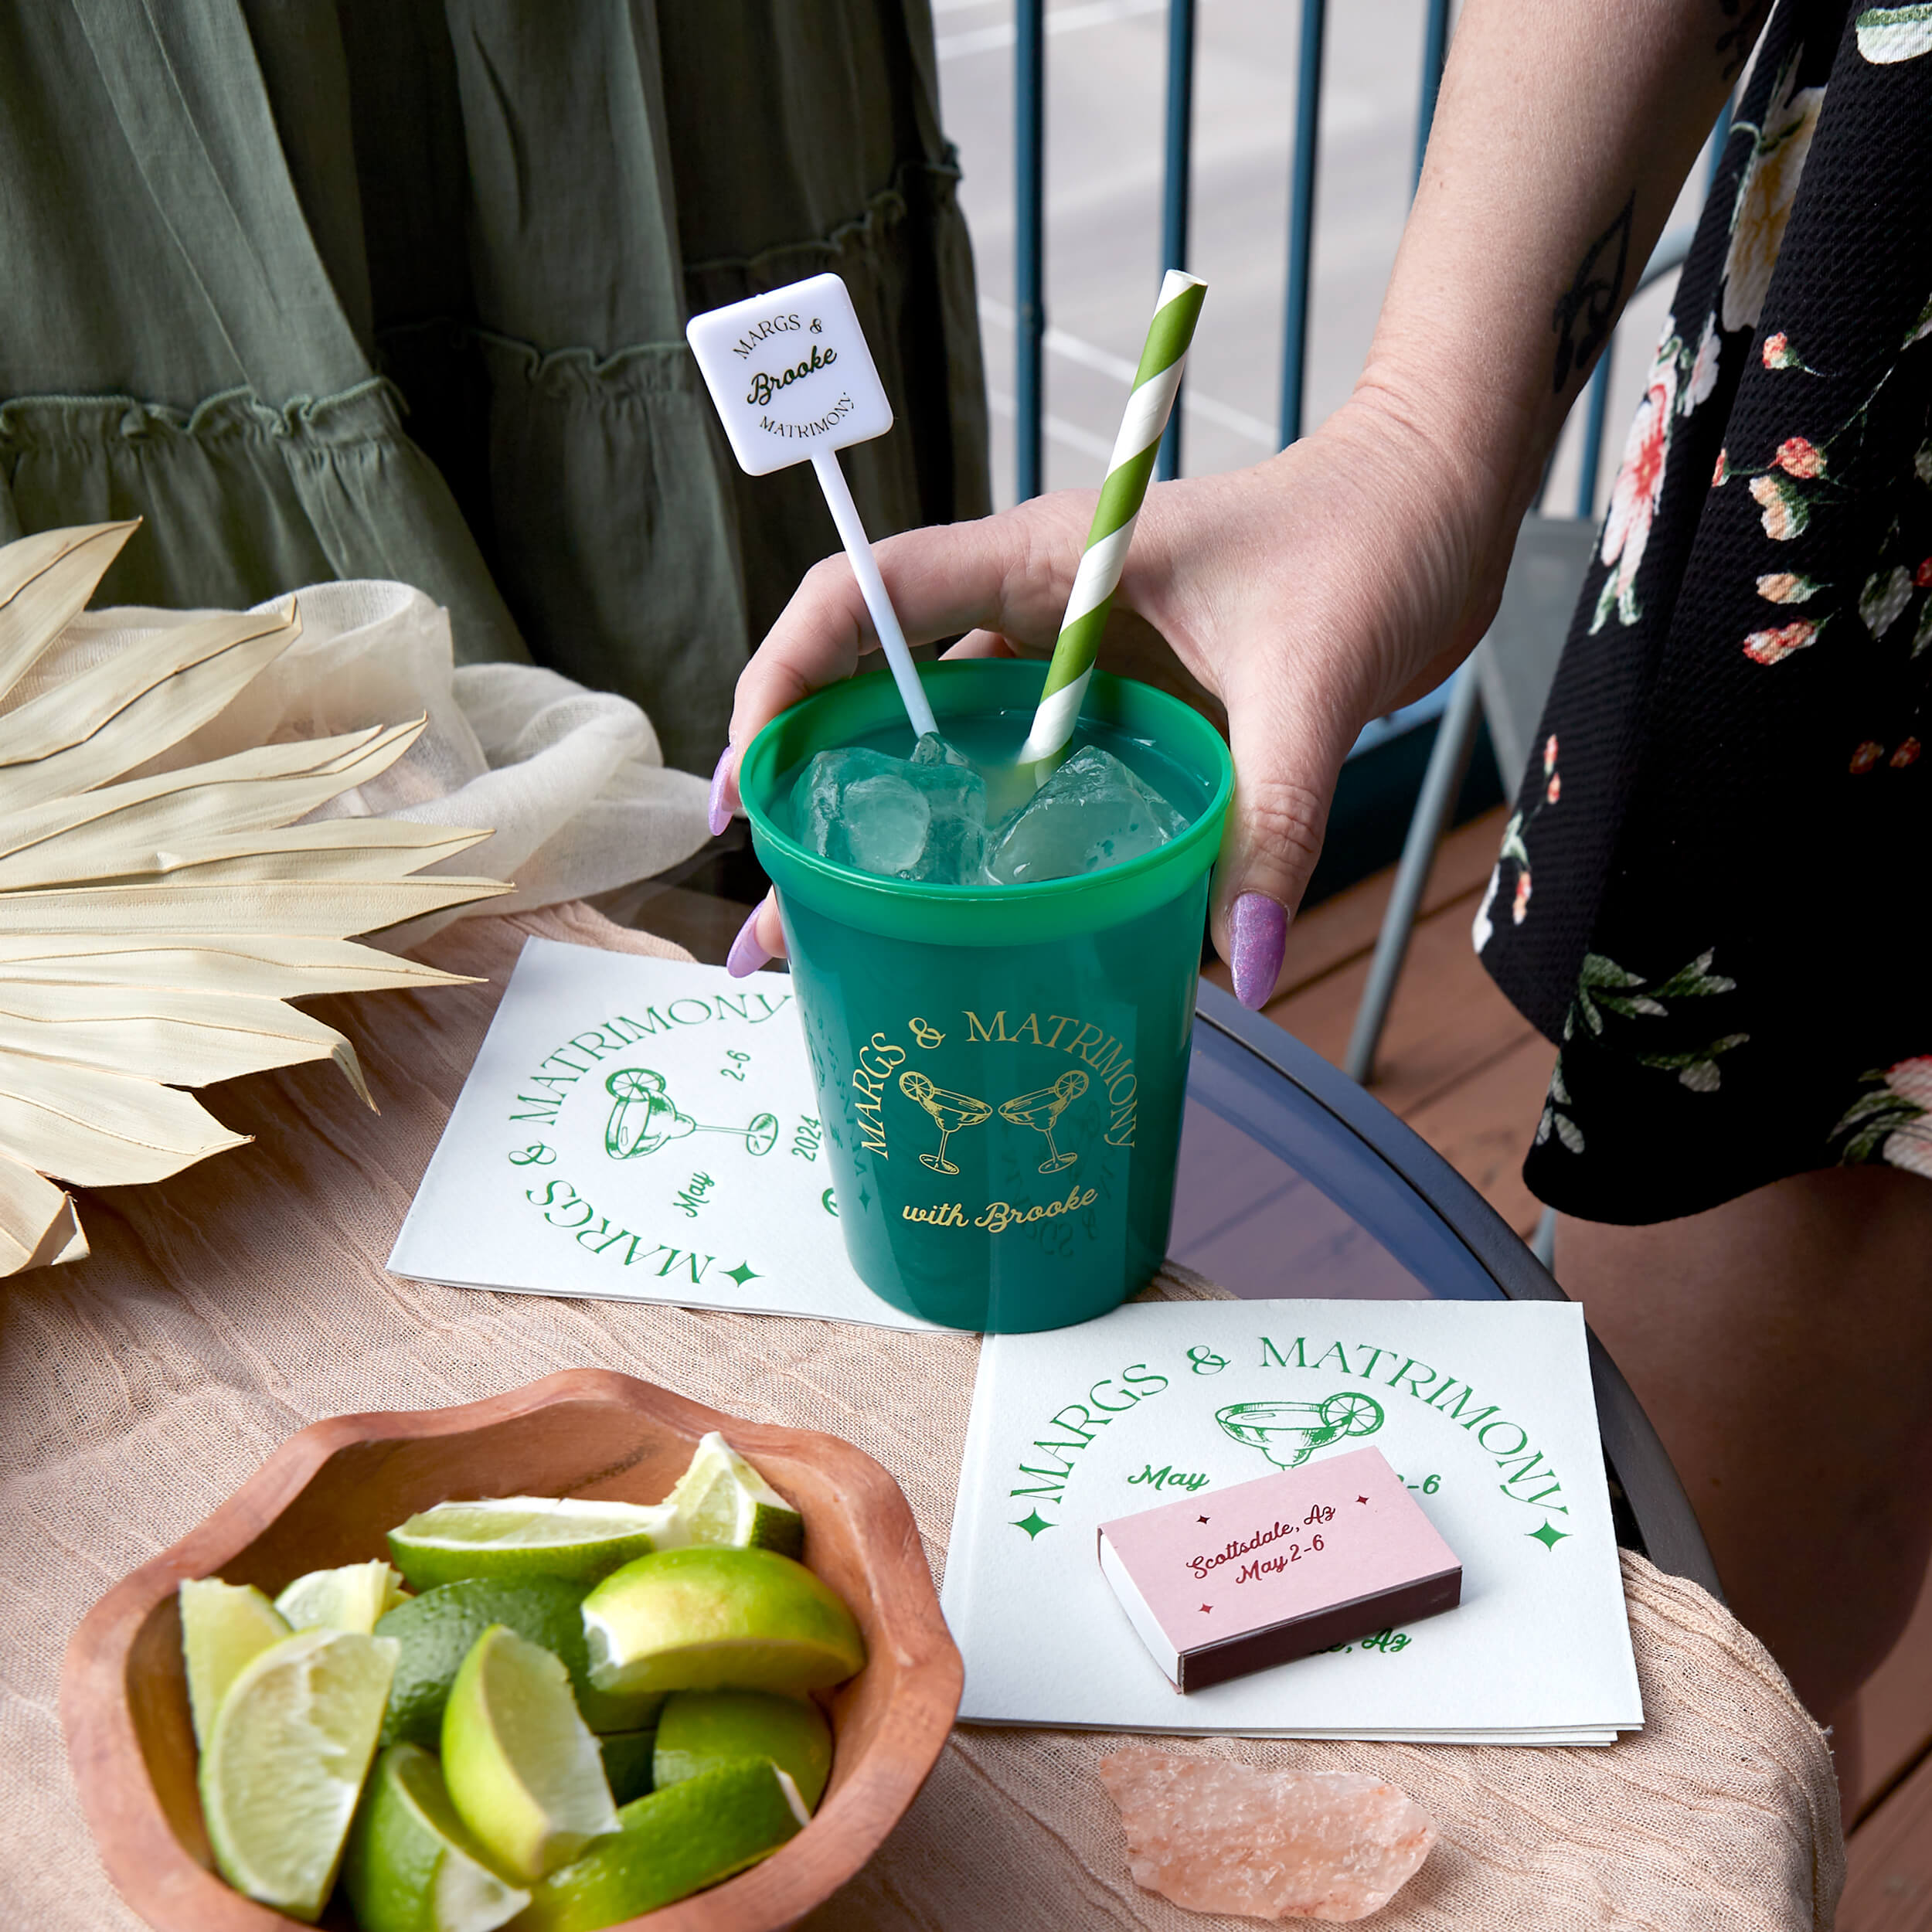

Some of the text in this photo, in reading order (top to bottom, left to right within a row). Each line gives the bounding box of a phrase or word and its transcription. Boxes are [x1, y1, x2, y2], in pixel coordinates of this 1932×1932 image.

[732, 314, 823, 360] MARGS &
[747, 345, 838, 406] Brooke
[759, 391, 855, 439] MATRIMONY
[852, 1032, 906, 1161] MARGS
[908, 1016, 947, 1049] &
[961, 1009, 1139, 1149] MATRIMONY
[508, 993, 793, 1284] MARGS & MATRIMONY
[672, 1049, 752, 1219] May 2-6
[791, 1114, 822, 1162] 2024
[902, 1185, 1099, 1233] with Brooke
[1009, 1336, 1570, 1516] MARGS & MATRIMONY
[1127, 1464, 1442, 1495] May -6
[1185, 1504, 1336, 1580] Scottsdale, Az
[1235, 1533, 1325, 1585] May 2-6
[1360, 1627, 1413, 1654] Az
